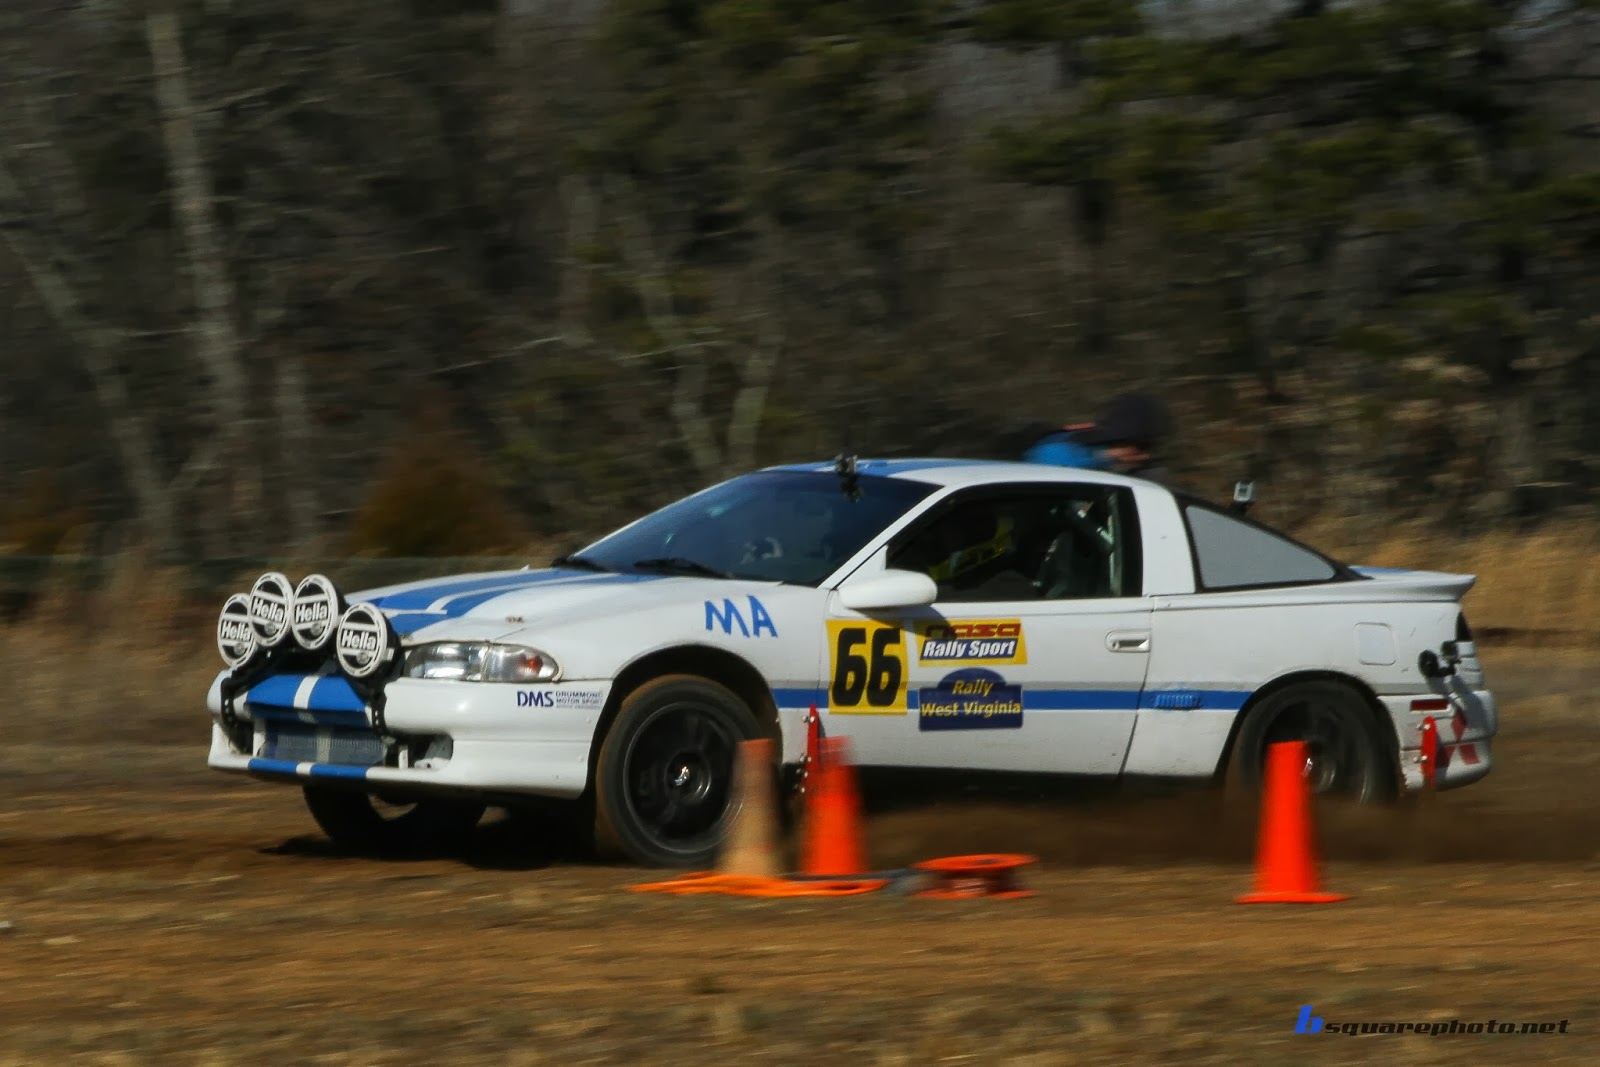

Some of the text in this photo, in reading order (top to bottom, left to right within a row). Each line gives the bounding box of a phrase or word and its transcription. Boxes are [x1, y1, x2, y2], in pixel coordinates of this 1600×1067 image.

[251, 597, 285, 623] Hella
[295, 601, 328, 623] Hella
[704, 595, 778, 638] MA
[220, 620, 251, 642] Hella
[341, 630, 376, 651] Hella
[923, 640, 1015, 658] Rally Sport
[832, 628, 902, 707] 66
[952, 679, 994, 697] Rally
[517, 691, 554, 707] DMS
[921, 700, 1021, 718] West Virginia
